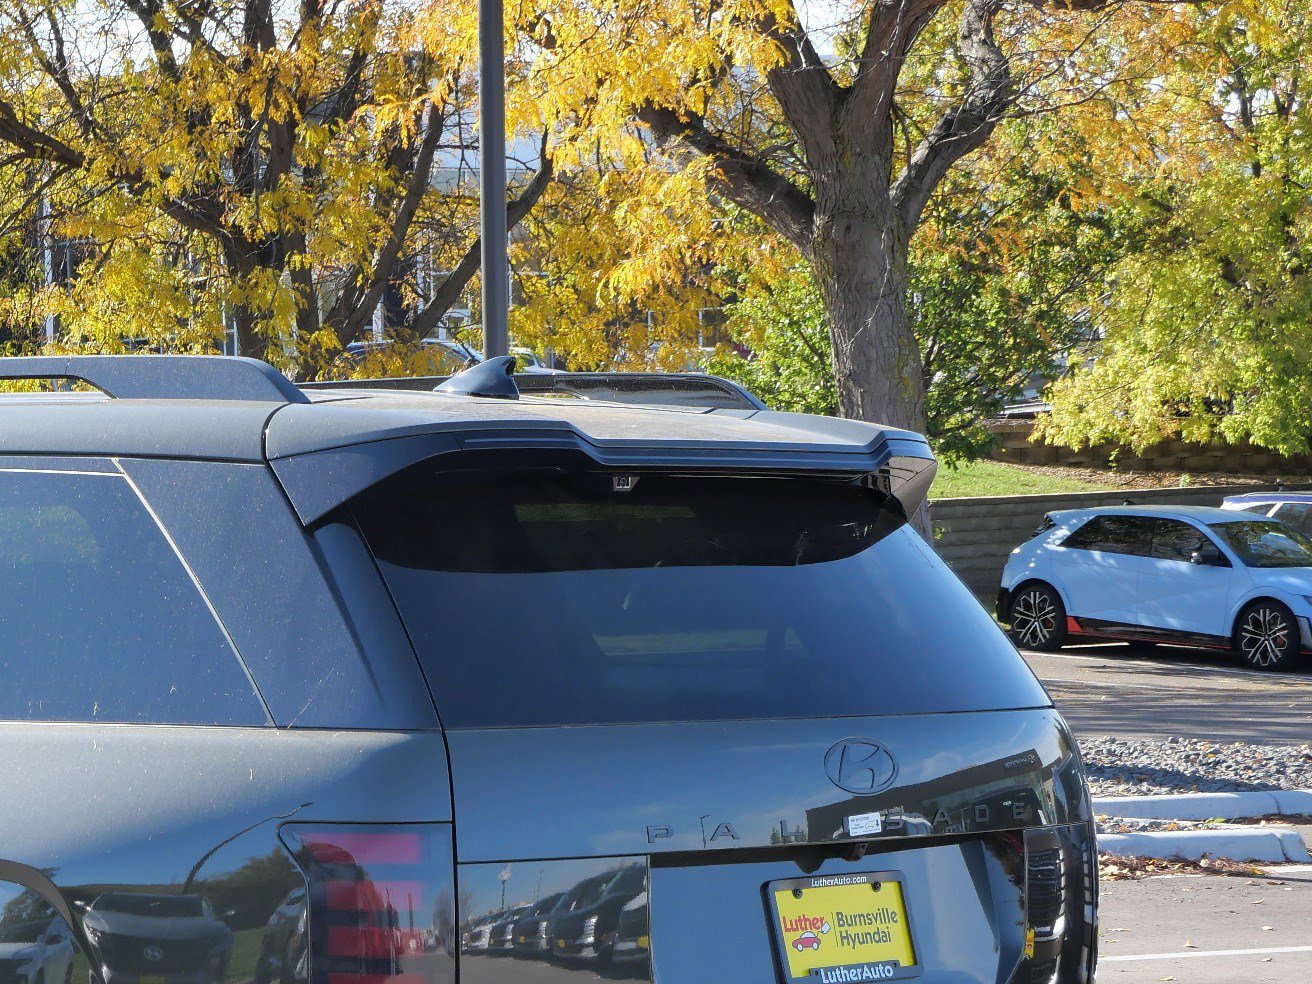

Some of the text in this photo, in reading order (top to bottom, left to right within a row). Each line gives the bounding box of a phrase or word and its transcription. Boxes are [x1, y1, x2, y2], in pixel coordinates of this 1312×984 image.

[646, 802, 1025, 844] PALISADE
[811, 876, 867, 887] LutherAuto.com
[782, 914, 825, 932] Luther
[836, 908, 898, 927] Burnsville
[839, 926, 892, 949] Hyundai
[820, 965, 894, 984] LutherAuto
